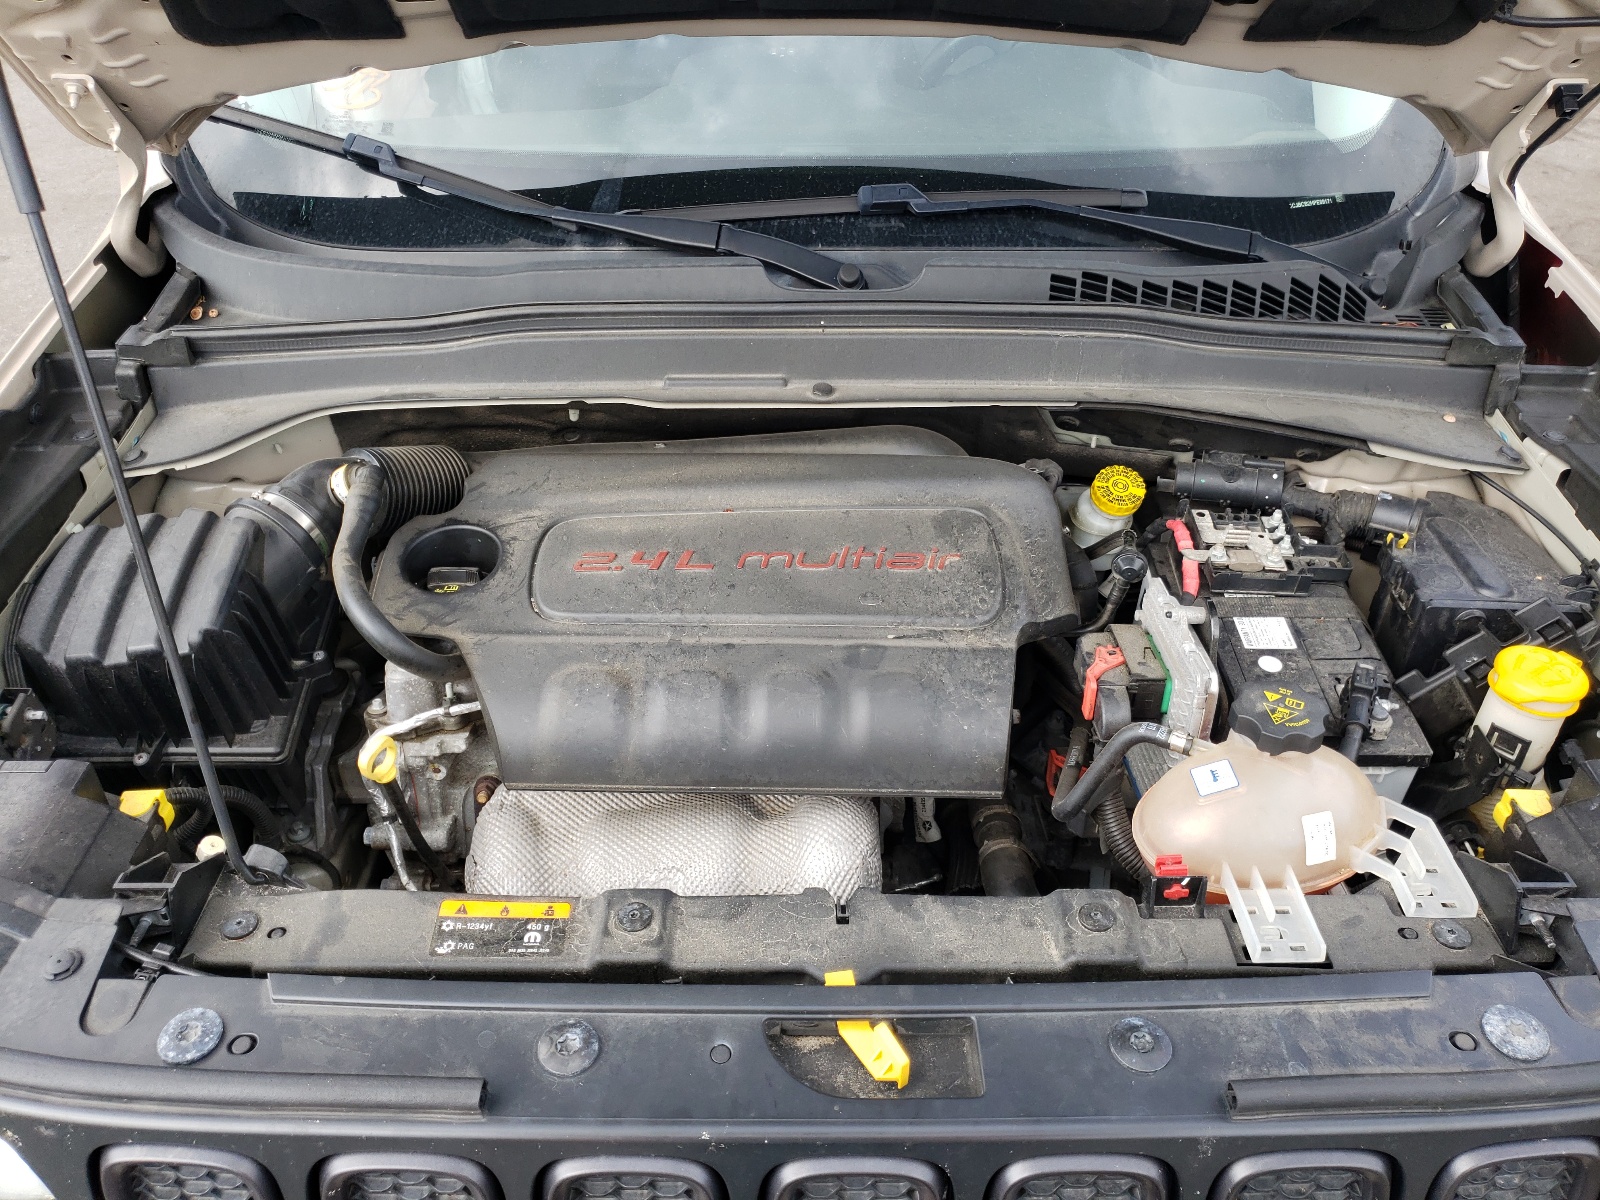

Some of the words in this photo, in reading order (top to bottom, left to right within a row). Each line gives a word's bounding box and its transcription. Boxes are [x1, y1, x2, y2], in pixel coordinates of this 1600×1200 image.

[736, 545, 962, 572] multiair
[456, 922, 493, 931] R-1234yf
[543, 924, 550, 932] g
[457, 942, 475, 950] PAG
